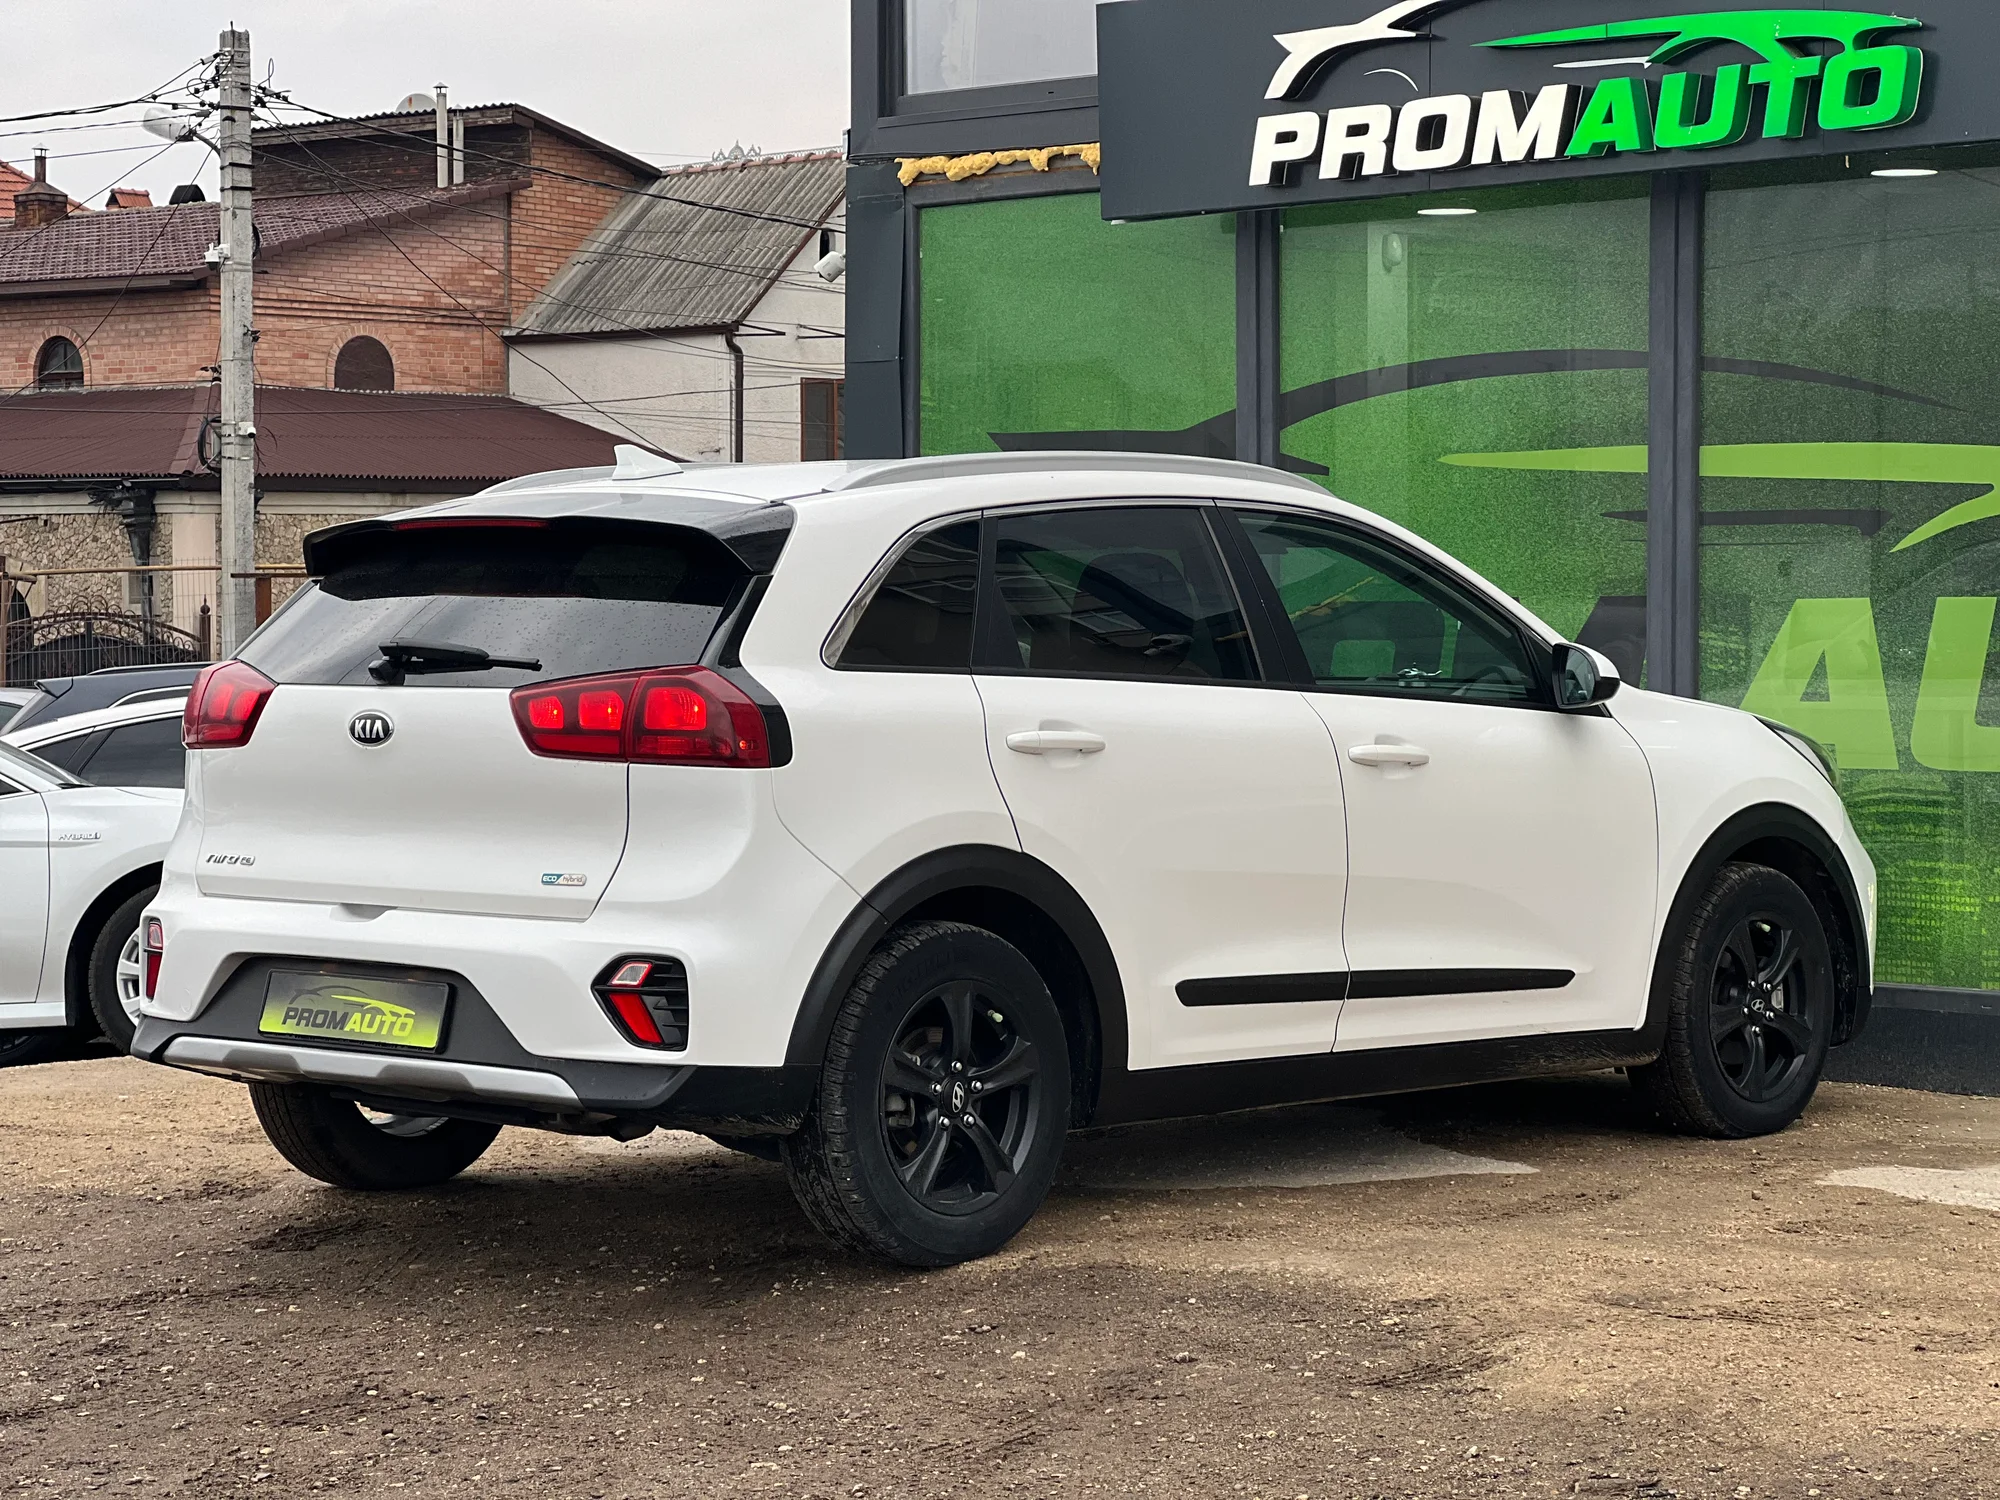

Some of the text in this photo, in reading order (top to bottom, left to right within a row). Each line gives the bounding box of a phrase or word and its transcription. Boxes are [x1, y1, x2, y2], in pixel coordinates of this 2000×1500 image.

[1249, 46, 1924, 187] PROMAUTO
[354, 719, 385, 739] KIA
[281, 1006, 415, 1037] PROMAUTO
